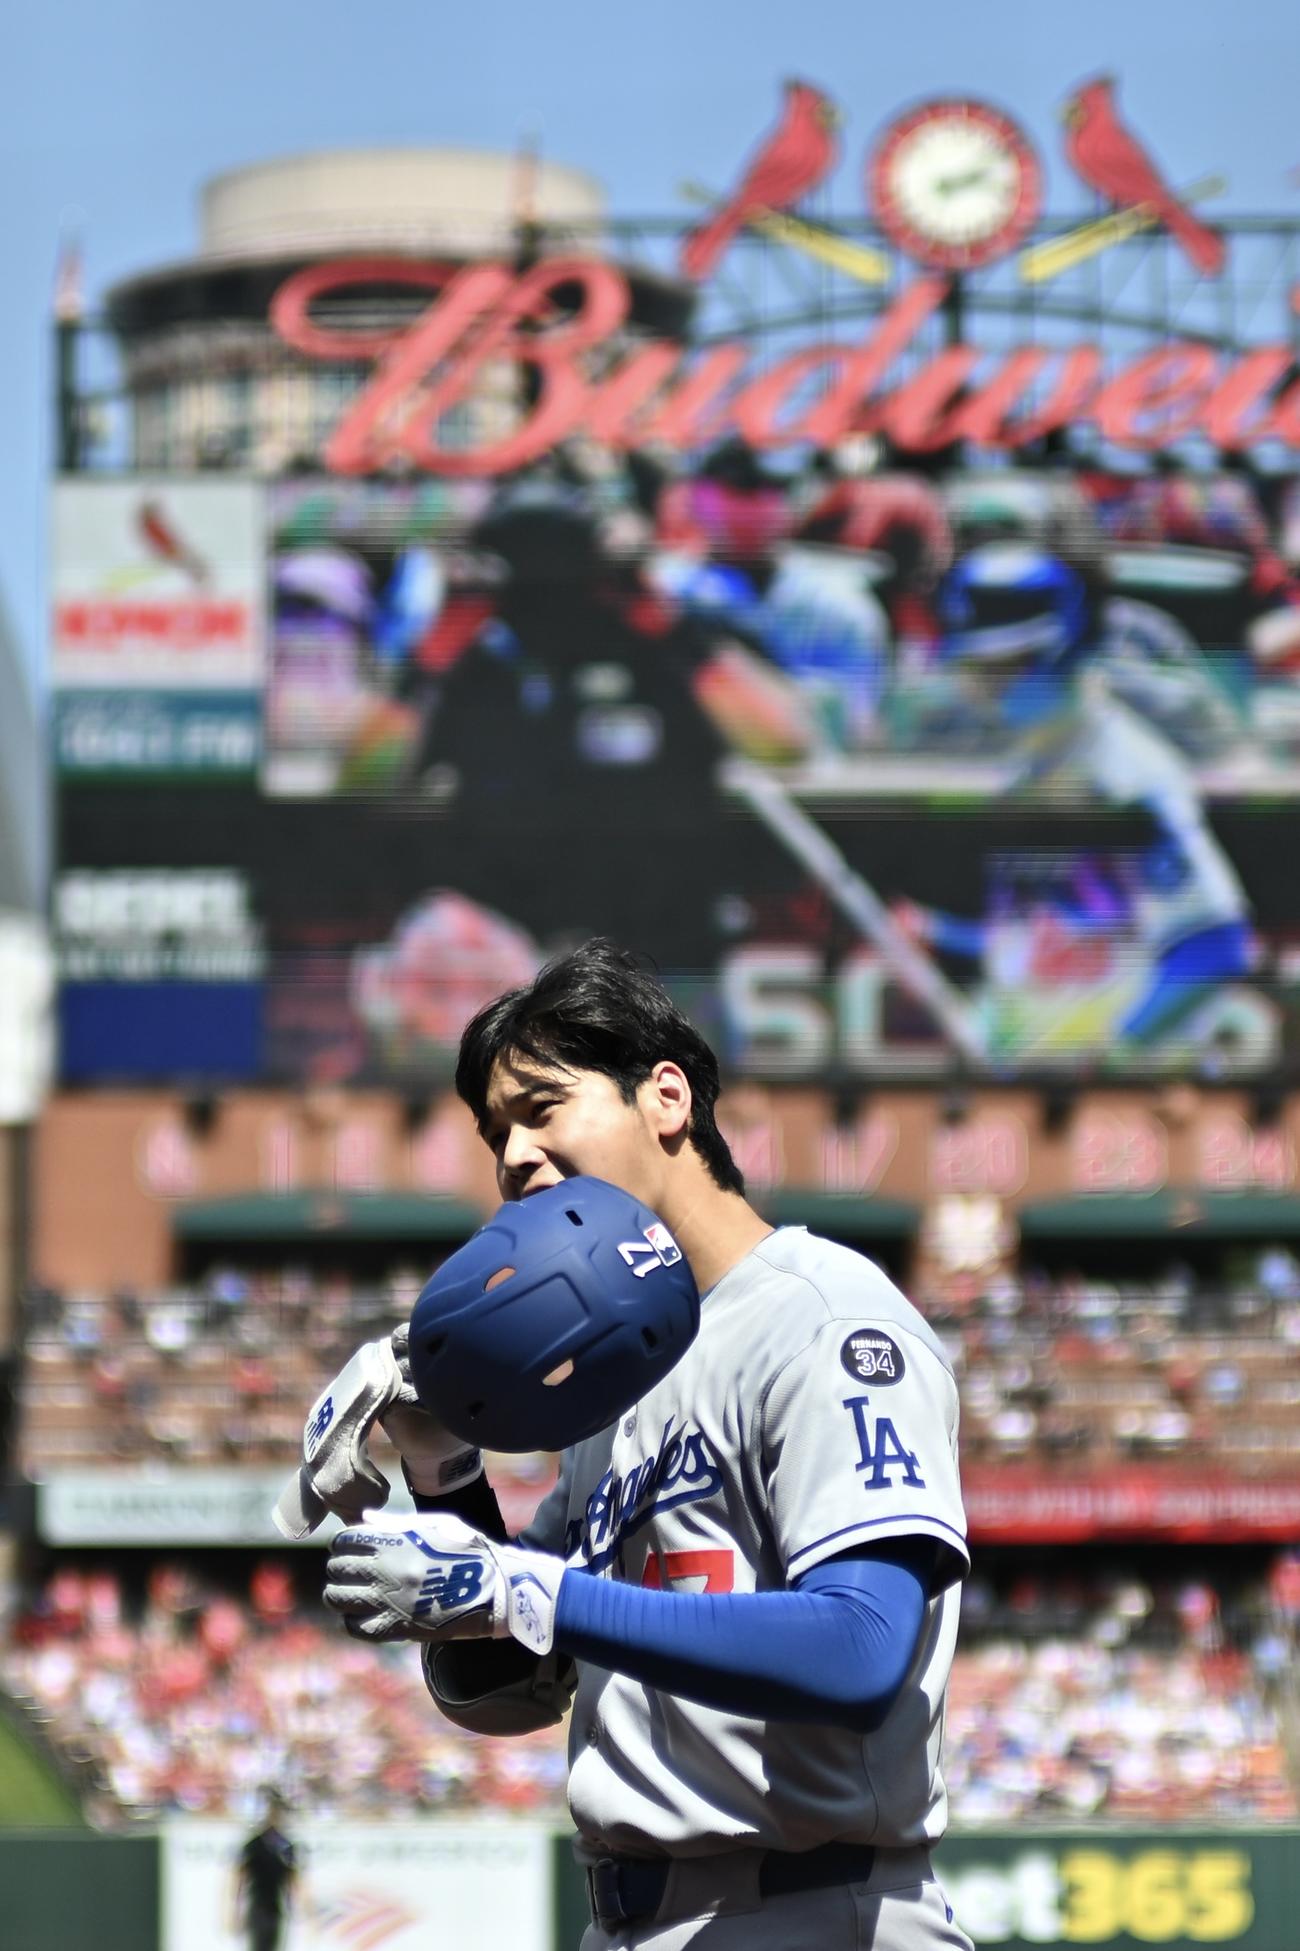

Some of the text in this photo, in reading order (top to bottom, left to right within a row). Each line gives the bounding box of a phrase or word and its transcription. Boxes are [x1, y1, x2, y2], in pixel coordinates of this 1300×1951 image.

[270, 257, 1300, 477] Budwei
[616, 1241, 662, 1278] 17
[850, 1339, 893, 1351] FERNANDO
[855, 1349, 895, 1377] 34
[842, 1396, 927, 1491] LA
[355, 1532, 404, 1547] balance
[936, 1848, 1255, 1943] et365
